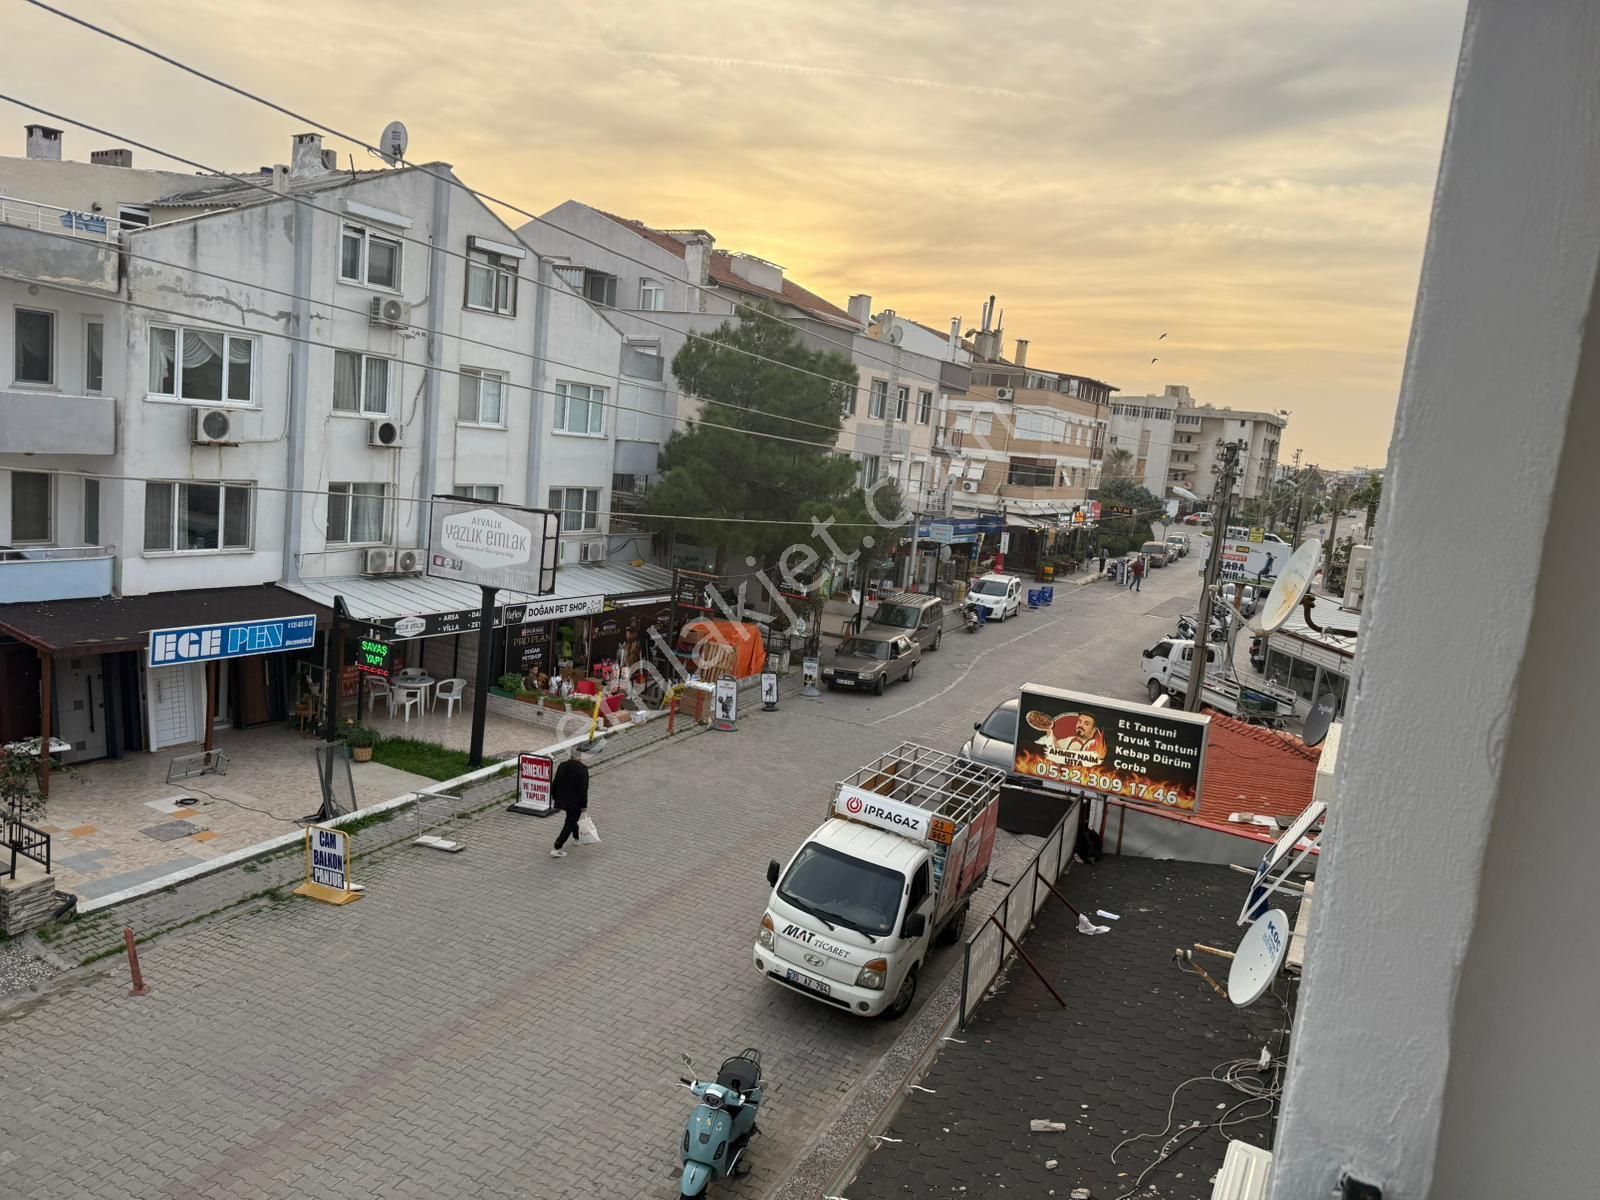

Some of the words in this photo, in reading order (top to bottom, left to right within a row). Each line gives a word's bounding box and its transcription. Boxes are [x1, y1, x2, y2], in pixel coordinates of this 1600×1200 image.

[472, 517, 502, 529] AYVALIK
[528, 604, 554, 617] DOĞAN
[556, 604, 568, 614] PET
[570, 602, 587, 612] SHOP
[442, 624, 460, 632] VİLLA
[154, 629, 222, 662] EGE
[228, 623, 284, 654] PEN
[362, 640, 388, 656] SAVAŞ
[1118, 719, 1130, 730] Et
[1134, 722, 1177, 738] Tantuni
[1118, 733, 1150, 748] Tavuk
[1154, 740, 1198, 756] Tantuni
[1048, 748, 1076, 758] AHMET
[1078, 753, 1098, 764] NAİM
[1064, 758, 1083, 766] USTA
[1116, 746, 1150, 762] Kebap
[1152, 753, 1192, 770] Dürüm
[522, 760, 550, 780] SİNEKLİK
[1114, 759, 1147, 774] Çorba
[523, 782, 529, 790] VE
[1036, 763, 1082, 784] 0532
[1088, 774, 1122, 792] 309
[1130, 782, 1148, 798] 17
[1153, 789, 1178, 804] 46
[526, 792, 546, 802] YAPILIR
[934, 820, 944, 830] 23
[320, 830, 336, 849] CAM
[314, 849, 342, 872] BALKON
[314, 868, 343, 888] PANJUR
[782, 924, 816, 944] MAT
[814, 939, 851, 959] TİCARET
